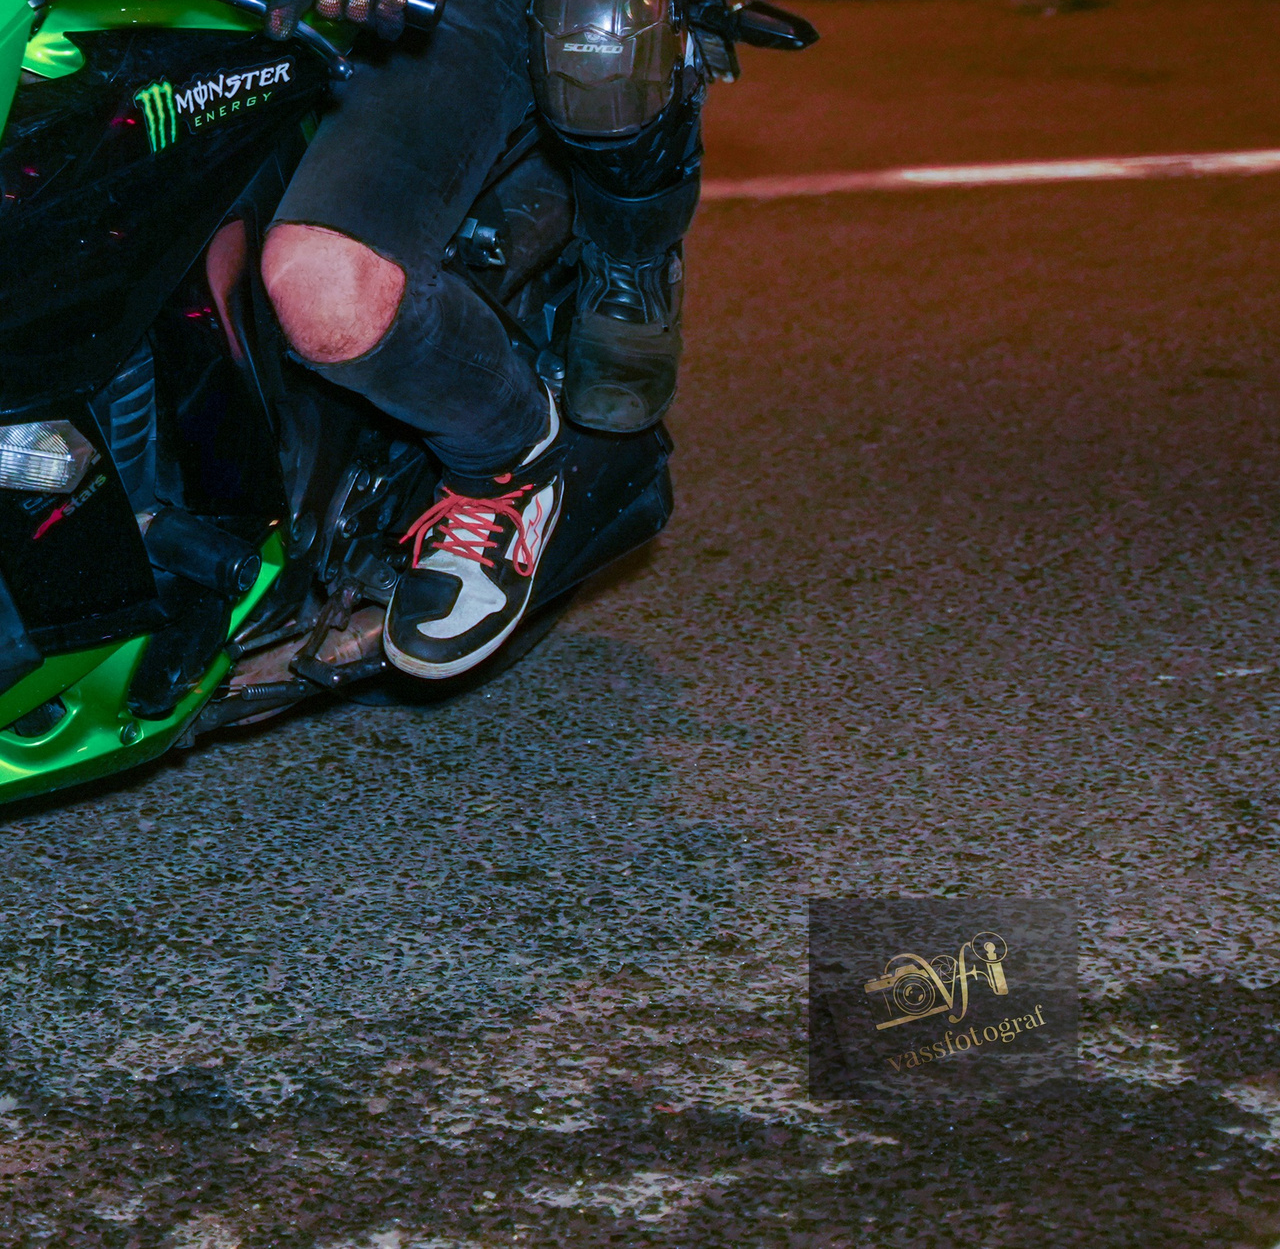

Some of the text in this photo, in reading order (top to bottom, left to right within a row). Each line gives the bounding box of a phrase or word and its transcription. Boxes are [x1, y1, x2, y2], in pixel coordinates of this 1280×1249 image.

[562, 42, 624, 54] SCOYCO
[174, 62, 291, 115] MONSTER
[194, 91, 272, 128] ENERGY
